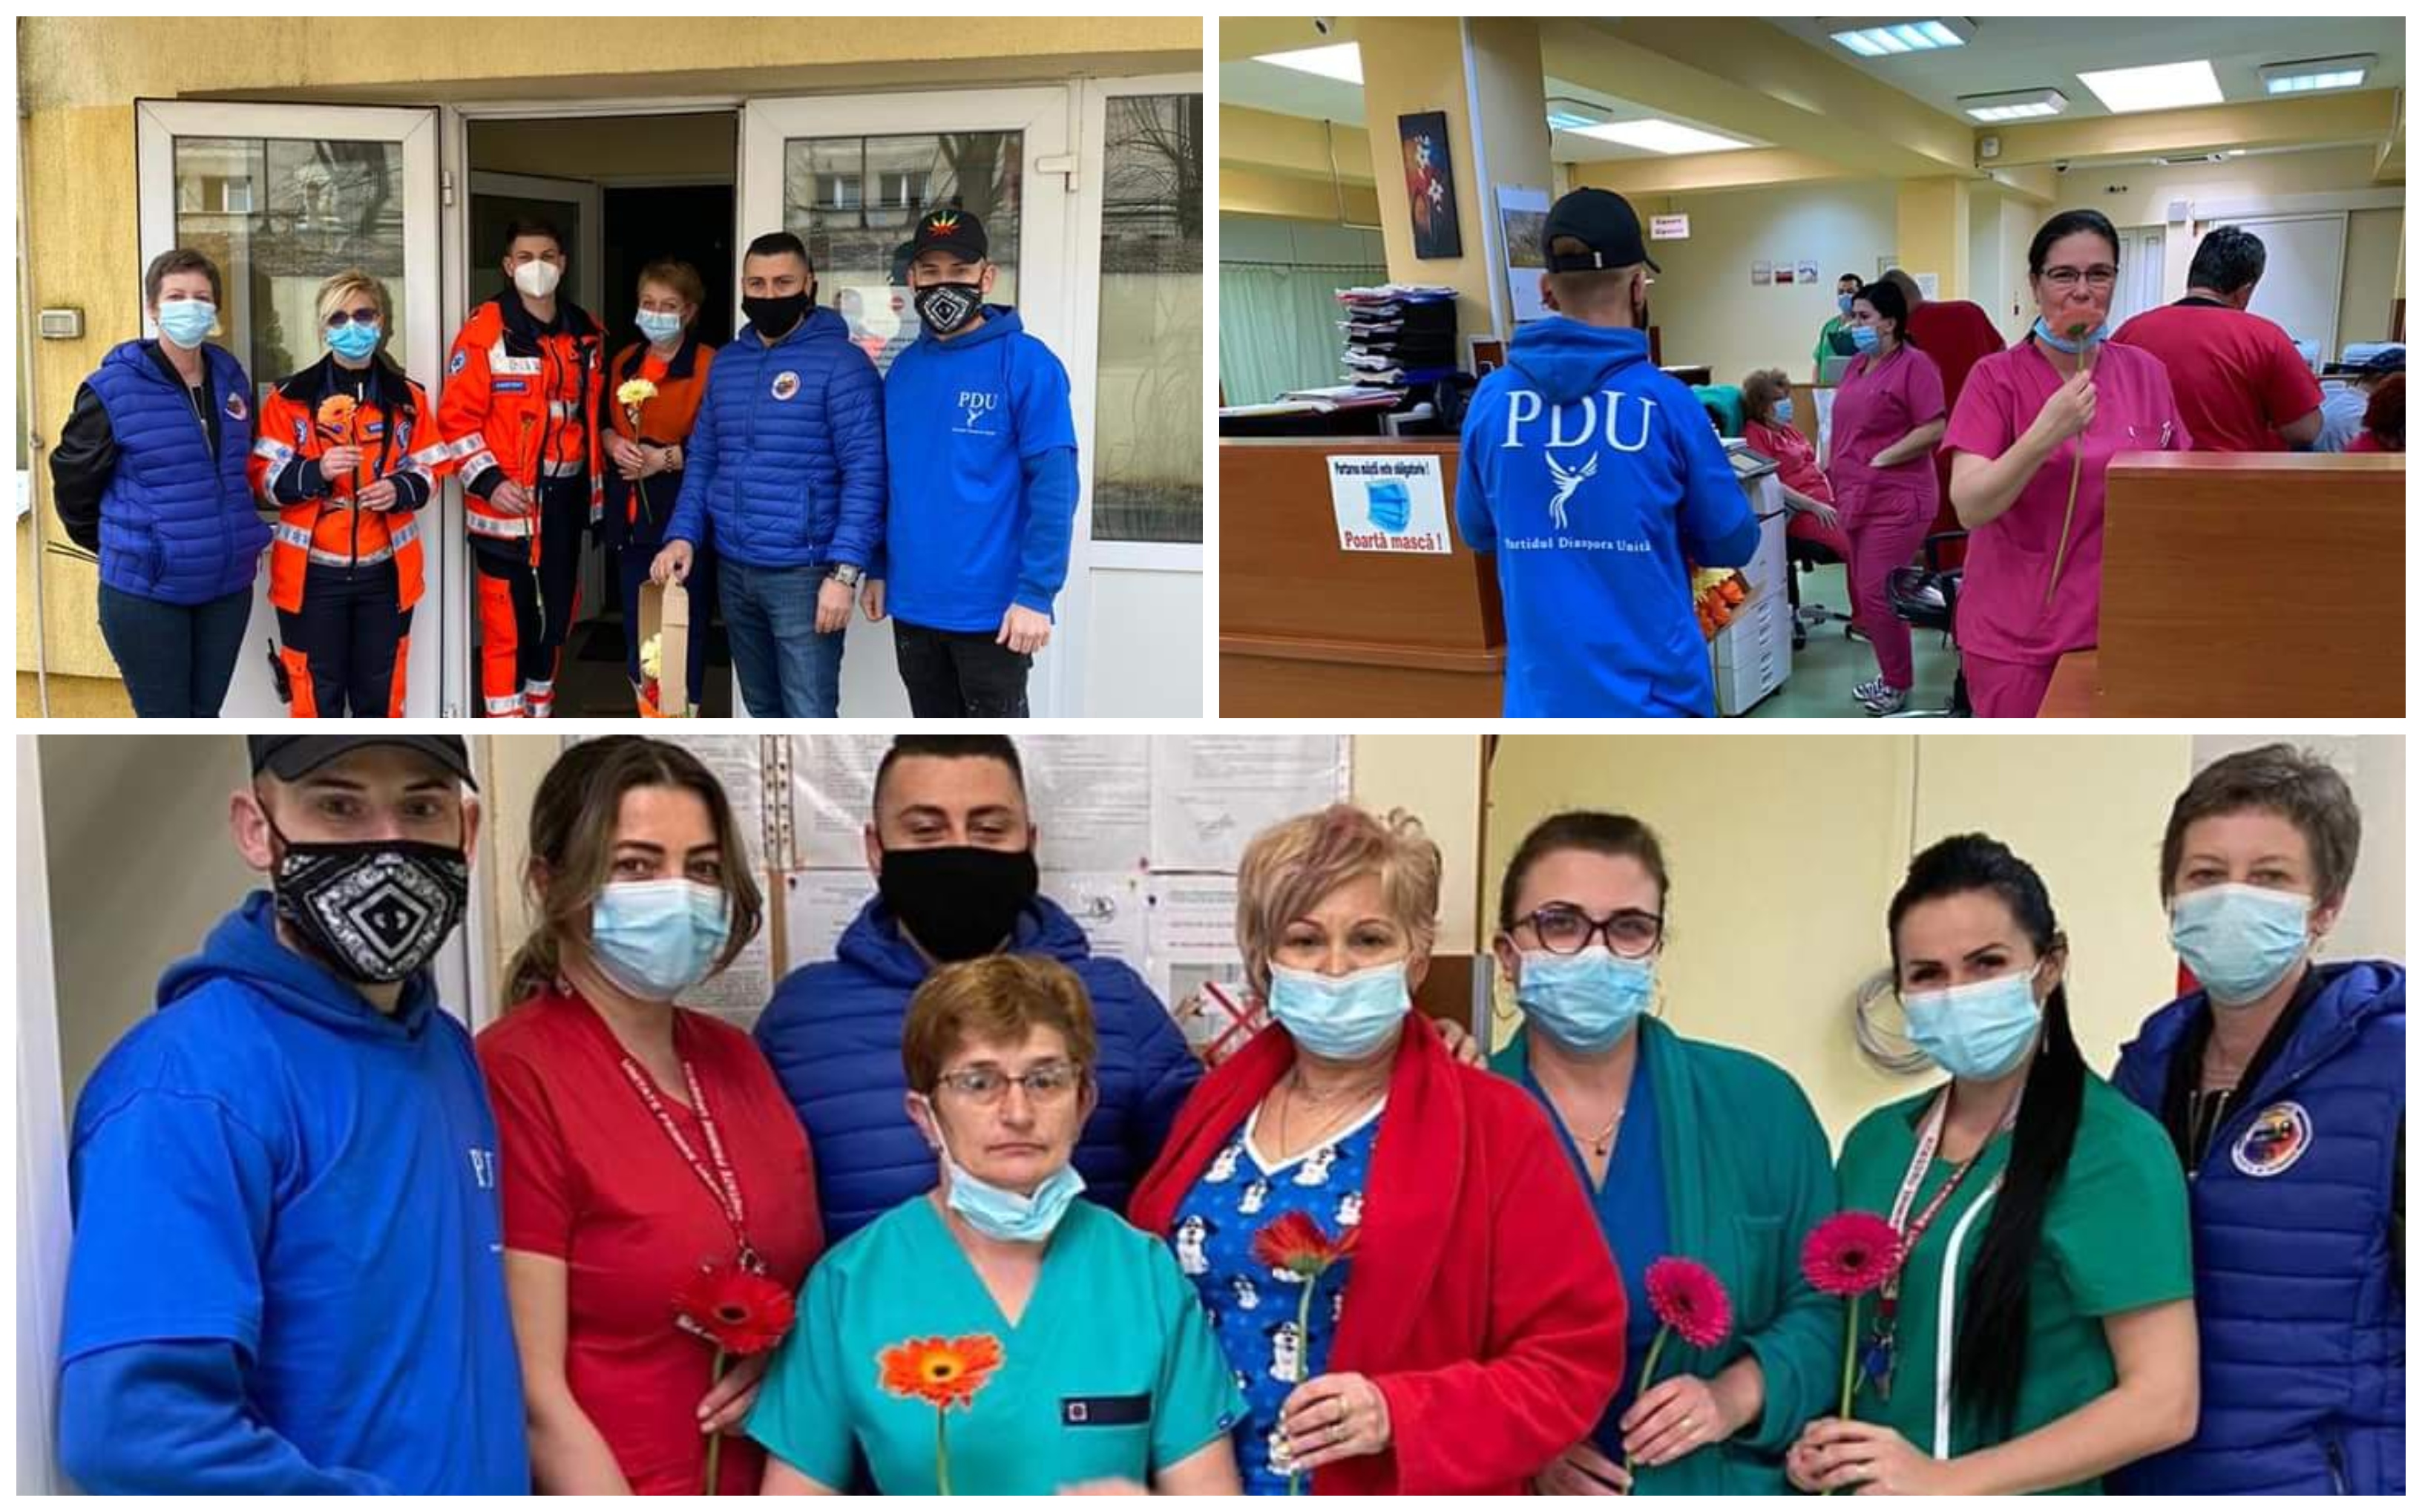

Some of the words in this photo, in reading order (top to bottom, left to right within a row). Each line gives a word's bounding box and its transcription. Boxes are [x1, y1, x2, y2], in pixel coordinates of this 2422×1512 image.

[958, 391, 999, 410] PDU
[1501, 389, 1657, 452] PDU
[1390, 532, 1434, 550] mască
[1558, 536, 1614, 551] Diaspora
